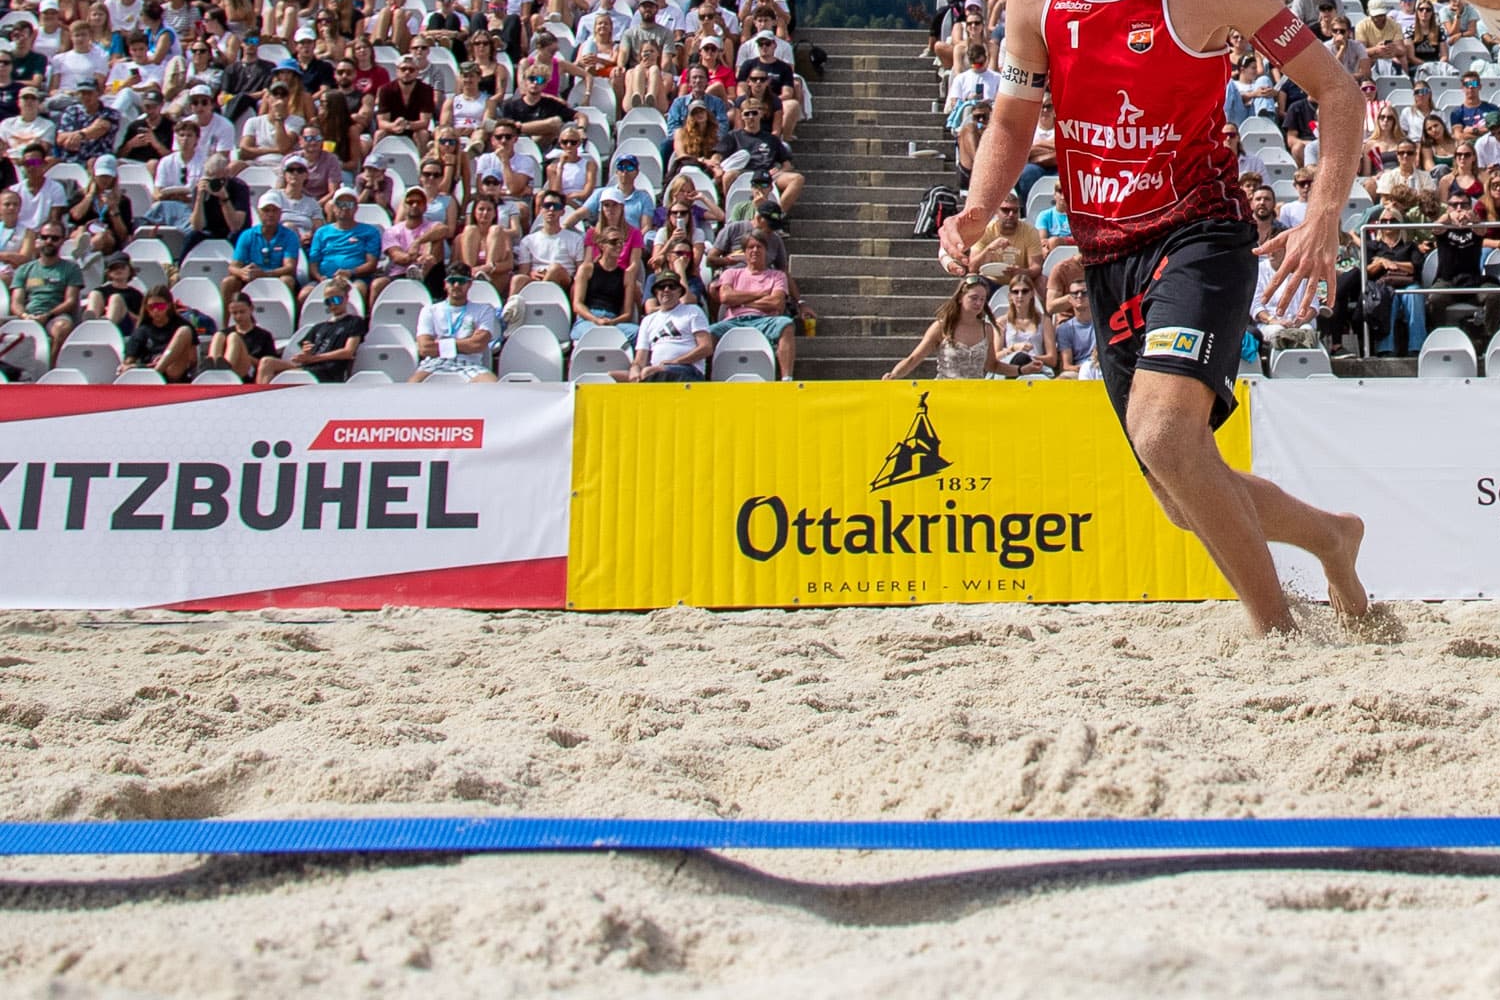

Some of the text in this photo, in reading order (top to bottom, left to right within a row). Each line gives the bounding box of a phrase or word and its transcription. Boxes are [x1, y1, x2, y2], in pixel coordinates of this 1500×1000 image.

[1067, 20, 1080, 49] 1
[1274, 18, 1304, 47] win2
[334, 426, 474, 444] CHAMPIONSHIPS
[0, 440, 480, 531] ITZBÜHEL
[936, 477, 992, 491] 1837
[736, 495, 1093, 569] Ottakringer
[808, 581, 927, 593] BRAUEREI
[962, 579, 1027, 591] WIEN
